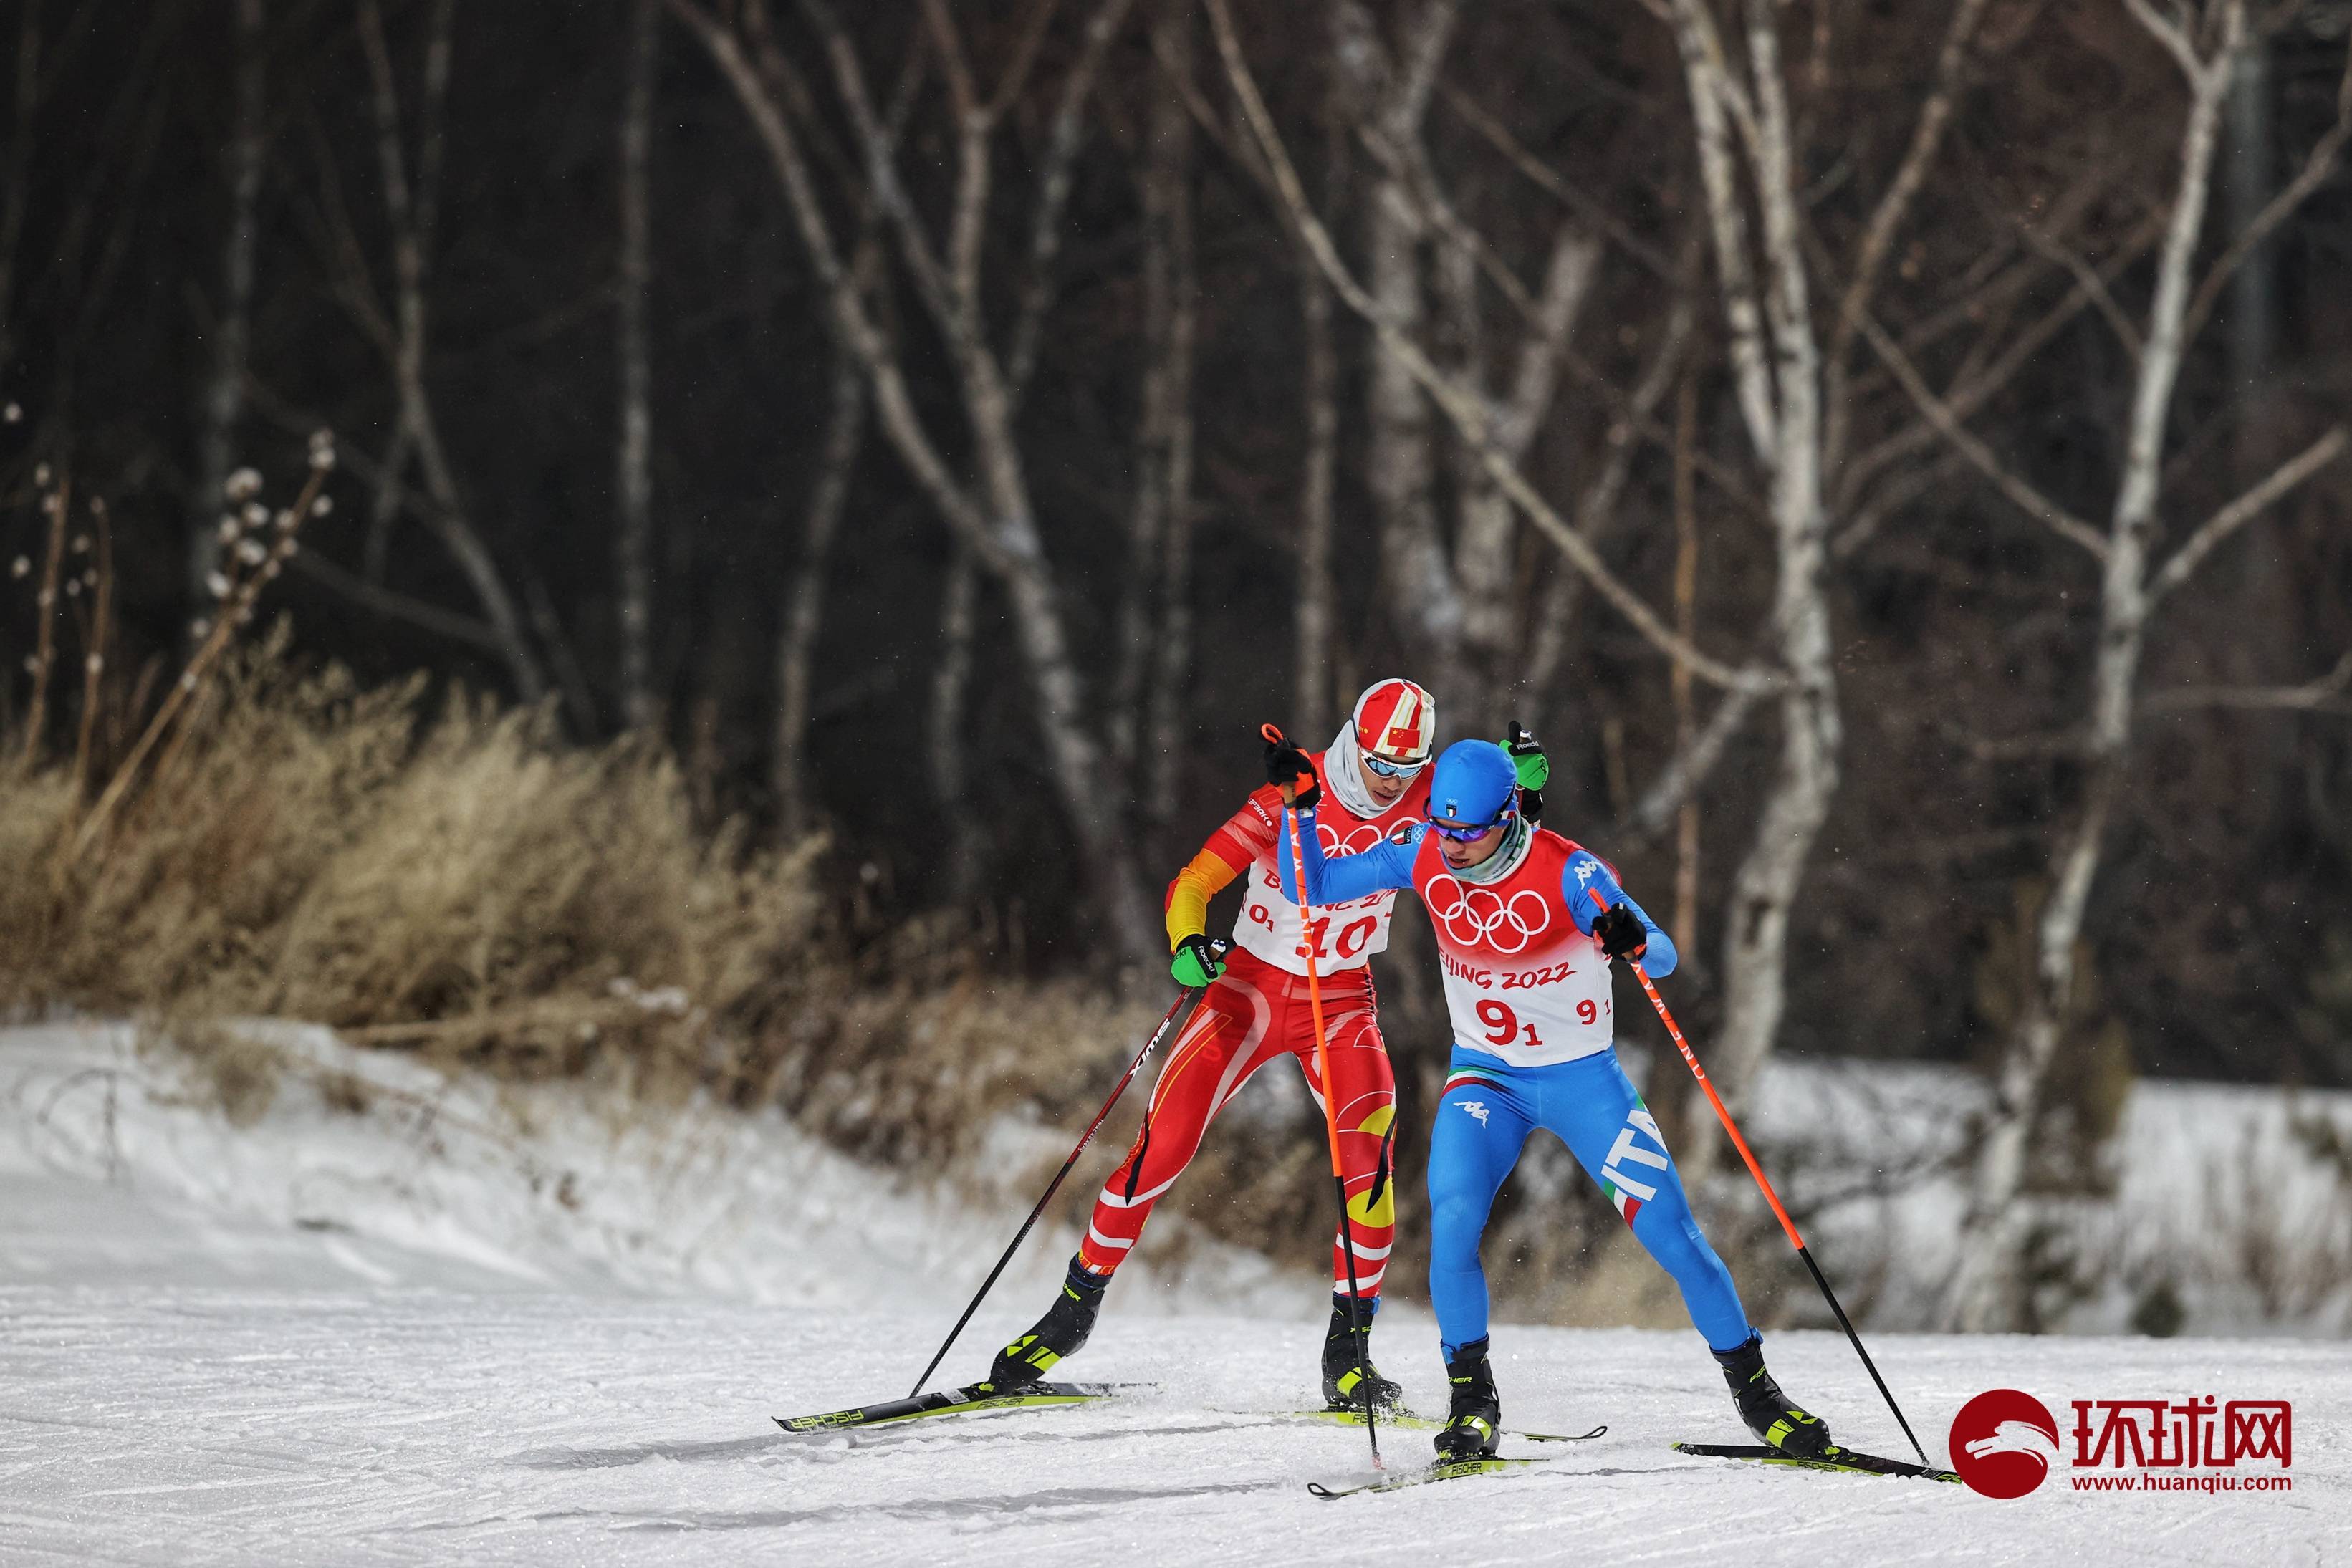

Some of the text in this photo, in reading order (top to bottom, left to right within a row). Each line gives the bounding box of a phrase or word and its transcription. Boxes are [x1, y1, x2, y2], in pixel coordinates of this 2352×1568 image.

[1295, 915, 1378, 959] 10
[1198, 945, 1215, 972] Roeckl
[1502, 961, 1577, 990] 2022
[790, 1409, 865, 1429] FISCHER
[1452, 1462, 1482, 1474] FISCHER
[1797, 1461, 1838, 1473] FISCHER
